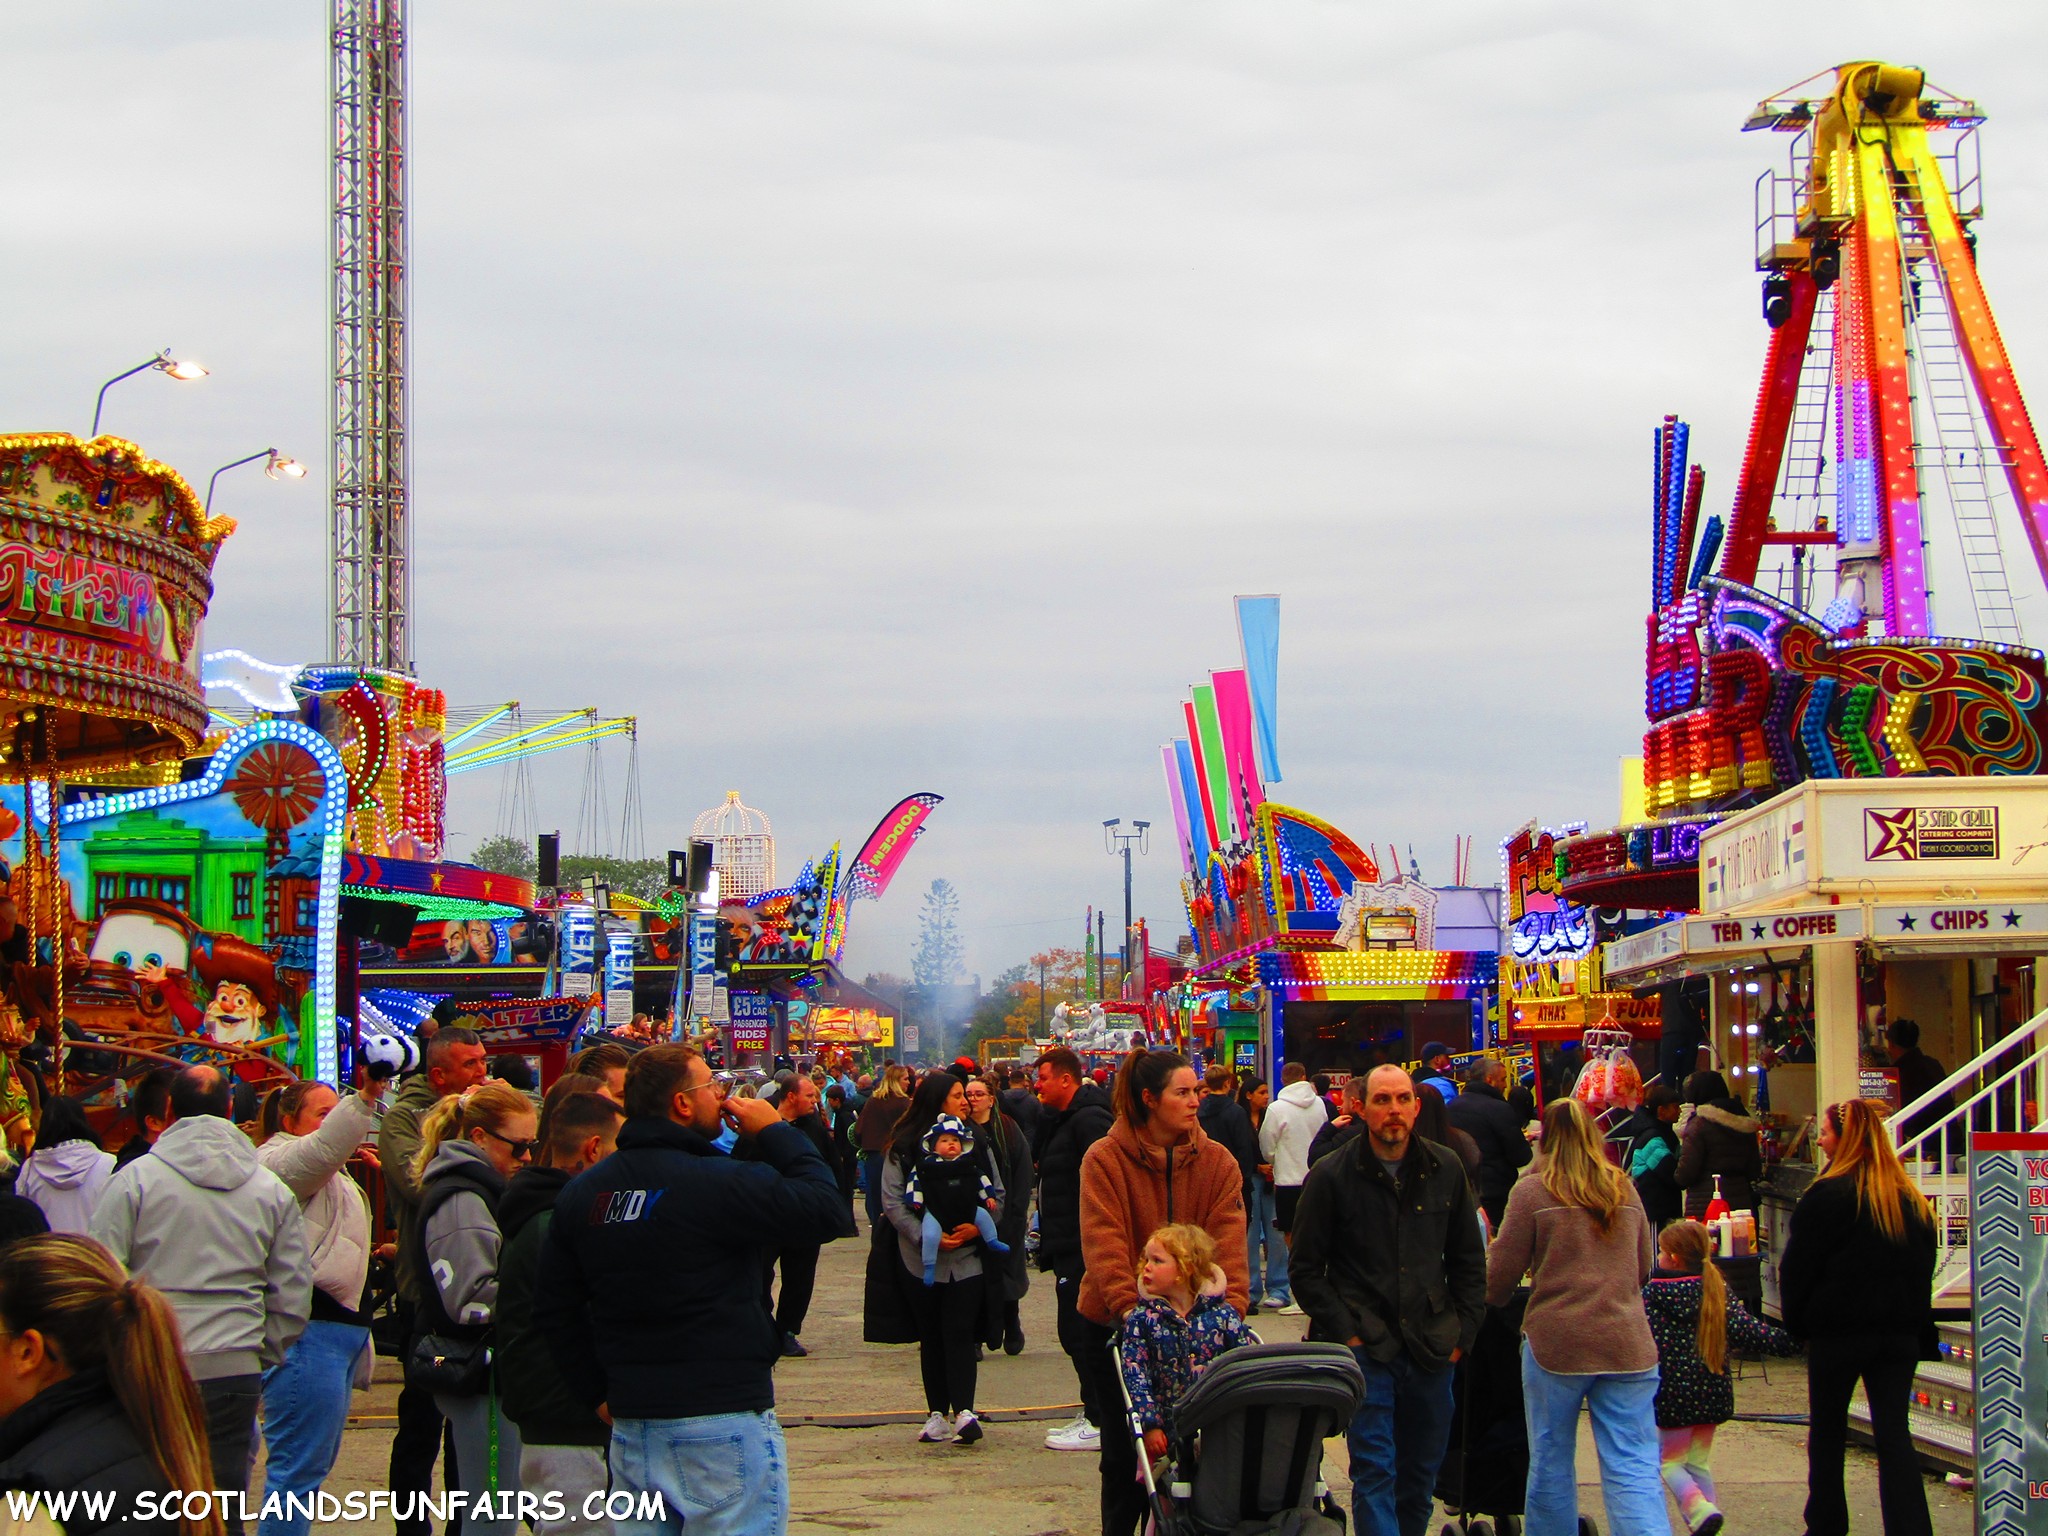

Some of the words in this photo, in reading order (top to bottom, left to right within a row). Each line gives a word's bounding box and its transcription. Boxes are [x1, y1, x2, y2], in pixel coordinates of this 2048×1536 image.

[1918, 809, 1929, 828] 5
[1930, 809, 1958, 828] STAR
[1960, 809, 1993, 828] GRILL
[869, 805, 922, 866] DODGEM
[1919, 830, 1954, 838] CATERING
[1956, 830, 1993, 838] COMPANY
[1742, 835, 1758, 887] STAR
[1760, 825, 1780, 880] GRILL
[1940, 844, 1966, 853] COOKED
[1966, 844, 1979, 852] FOR
[1980, 844, 1993, 852] YOU
[1505, 830, 1581, 926] Fre
[1512, 896, 1588, 957] out
[1711, 922, 1743, 943] TEA
[1772, 914, 1837, 938] COFFEE
[1930, 910, 1989, 931] CHIPS
[569, 912, 595, 968] YETI
[697, 915, 716, 971] YETI
[611, 939, 634, 986] YETI
[733, 996, 751, 1016] £5
[752, 996, 766, 1005] PER
[752, 1007, 768, 1016] CAR
[1537, 1005, 1567, 1022] ATHA'S
[451, 1003, 574, 1029] WALTZER
[733, 1019, 768, 1028] PASSENGER
[481, 1028, 532, 1042] XL
[734, 1030, 767, 1039] RIDES
[737, 1040, 765, 1049] FREE
[1859, 1079, 1890, 1088] ausages
[1860, 1070, 1884, 1078] German
